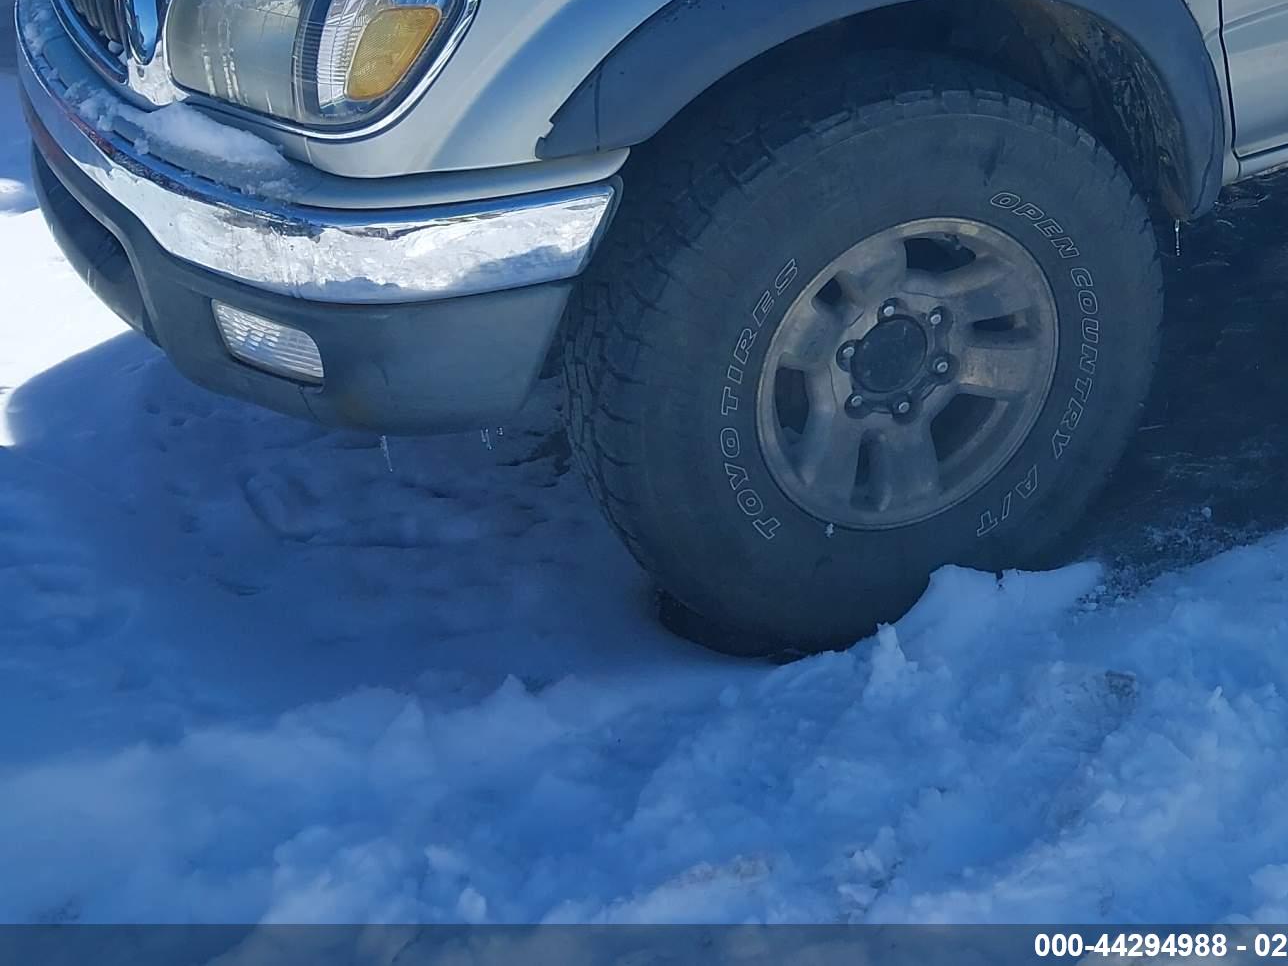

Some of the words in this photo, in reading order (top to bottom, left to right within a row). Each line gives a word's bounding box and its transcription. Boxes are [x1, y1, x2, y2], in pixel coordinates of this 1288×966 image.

[990, 191, 1081, 260] OPEN
[720, 257, 800, 417] TIRES
[1053, 266, 1100, 460] COUNTRY
[719, 426, 781, 540] TOYO
[975, 464, 1041, 538] A/T
